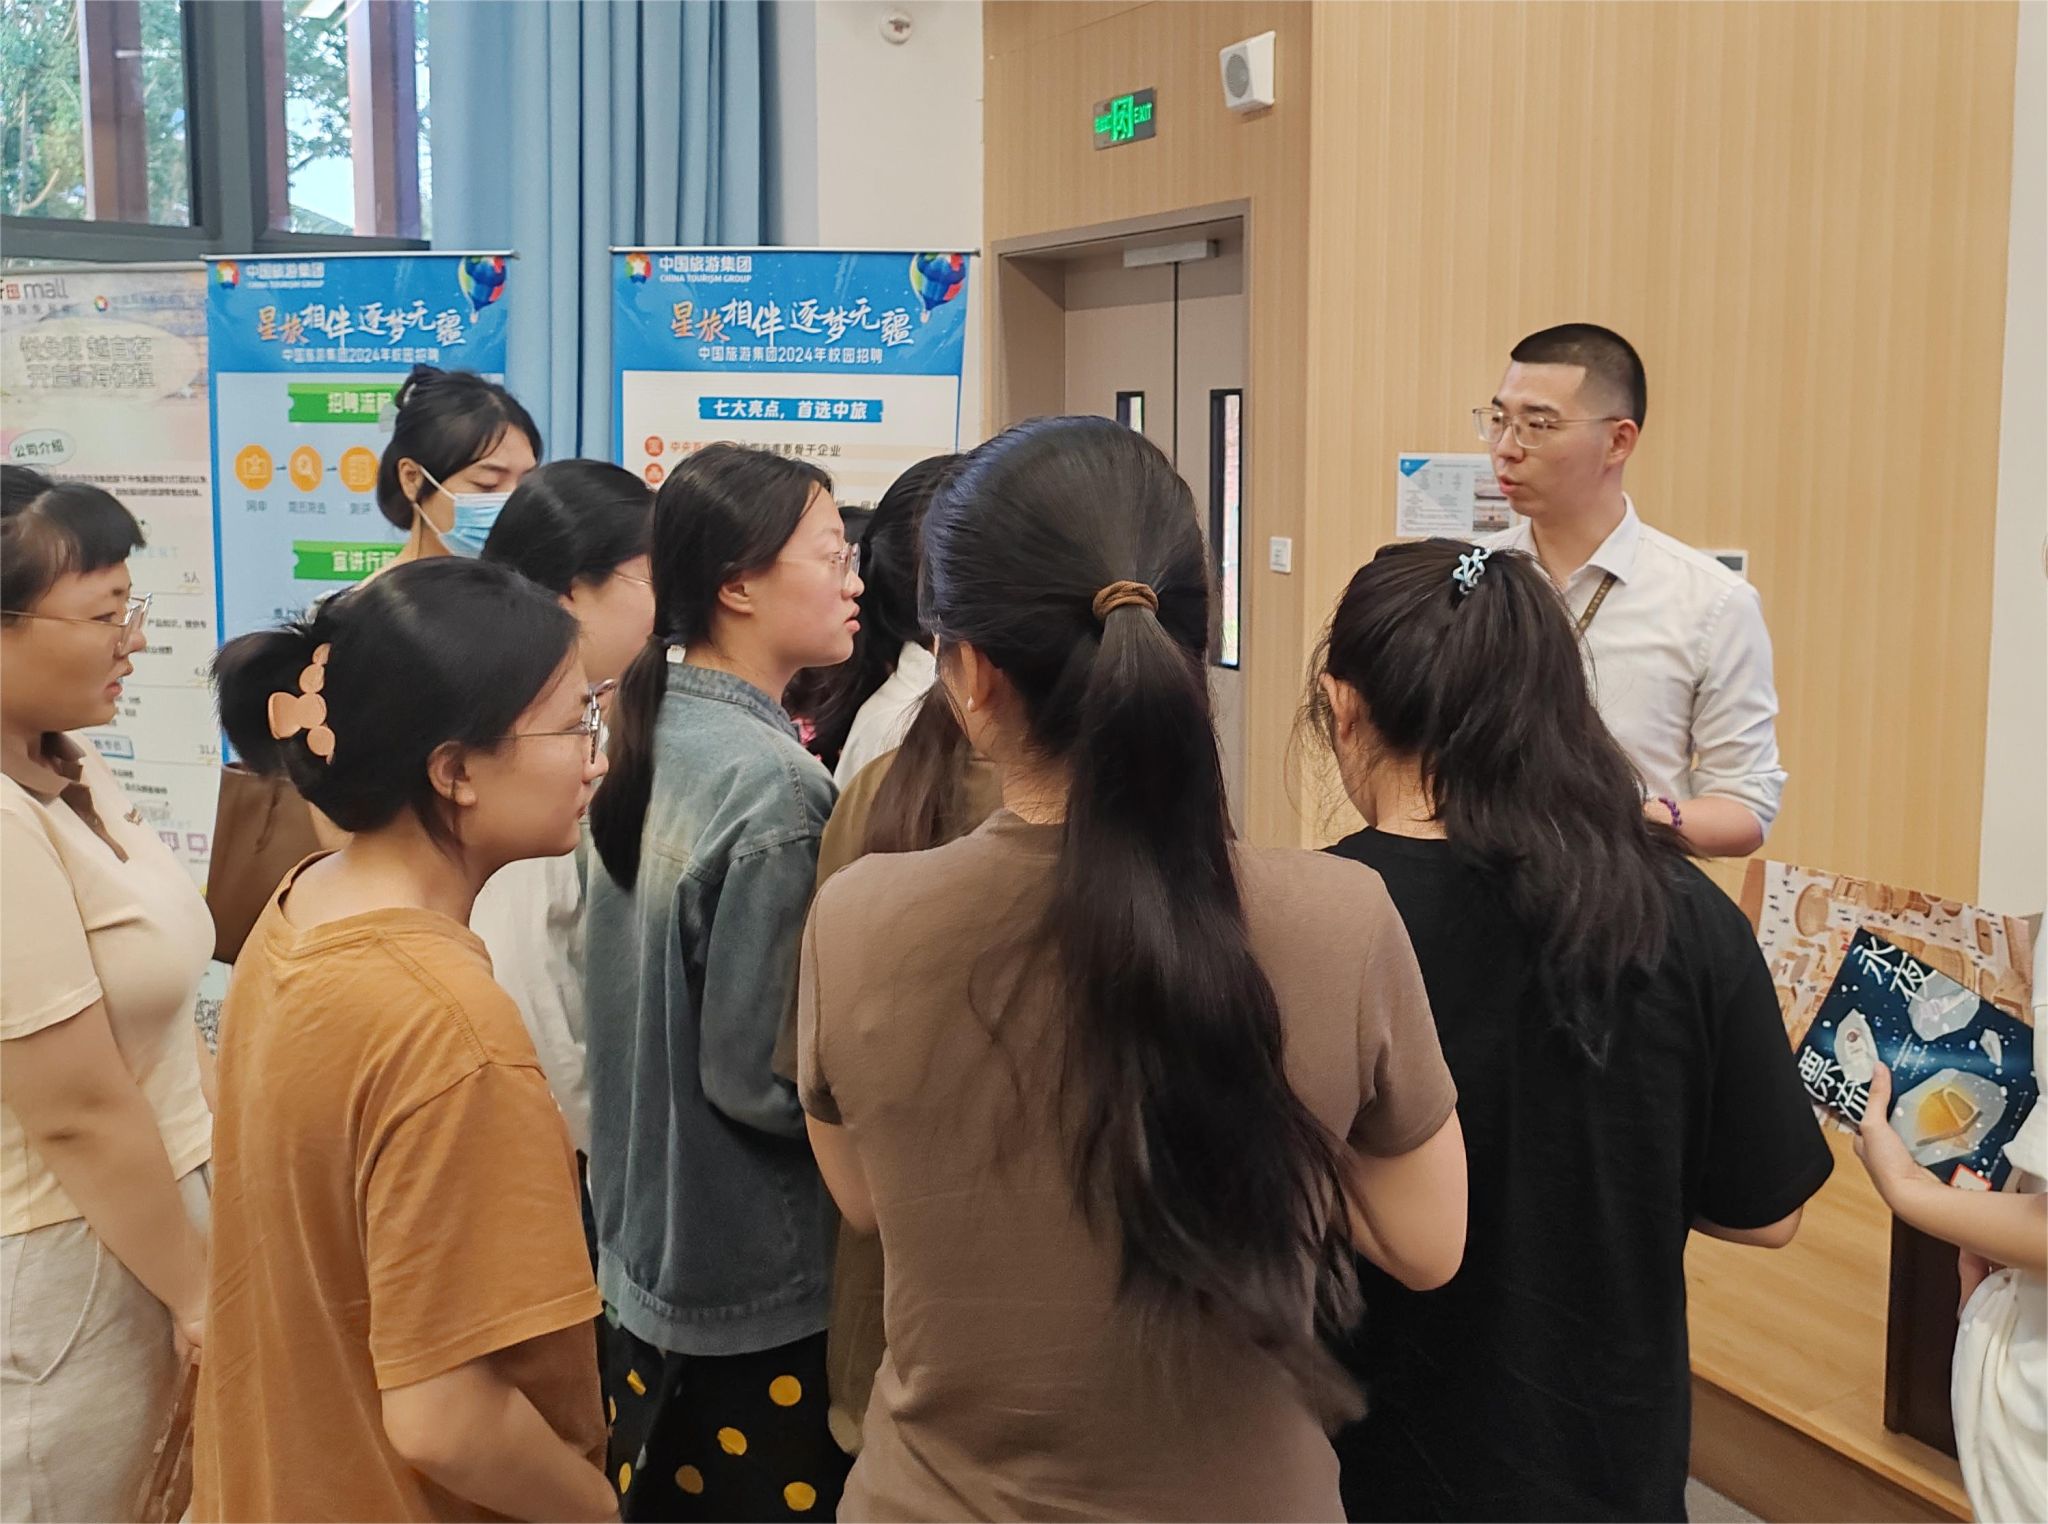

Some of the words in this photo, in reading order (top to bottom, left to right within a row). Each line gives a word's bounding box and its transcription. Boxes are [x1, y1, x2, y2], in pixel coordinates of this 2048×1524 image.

[659, 255, 752, 273] 中国旅游集团
[23, 277, 69, 299] mall
[661, 274, 686, 283] CHINA
[687, 274, 722, 284] TOURISM
[723, 274, 752, 283] GROUP
[257, 302, 354, 349] 星旅相伴
[358, 300, 467, 347] 逐梦无疆
[671, 297, 786, 347] 星旅相伴
[790, 297, 914, 347] 逐梦无疆
[699, 346, 883, 364] 中国旅游集团2024年校园招聘
[14, 438, 65, 457] 公司介绍
[1853, 936, 1938, 1001] 永夜
